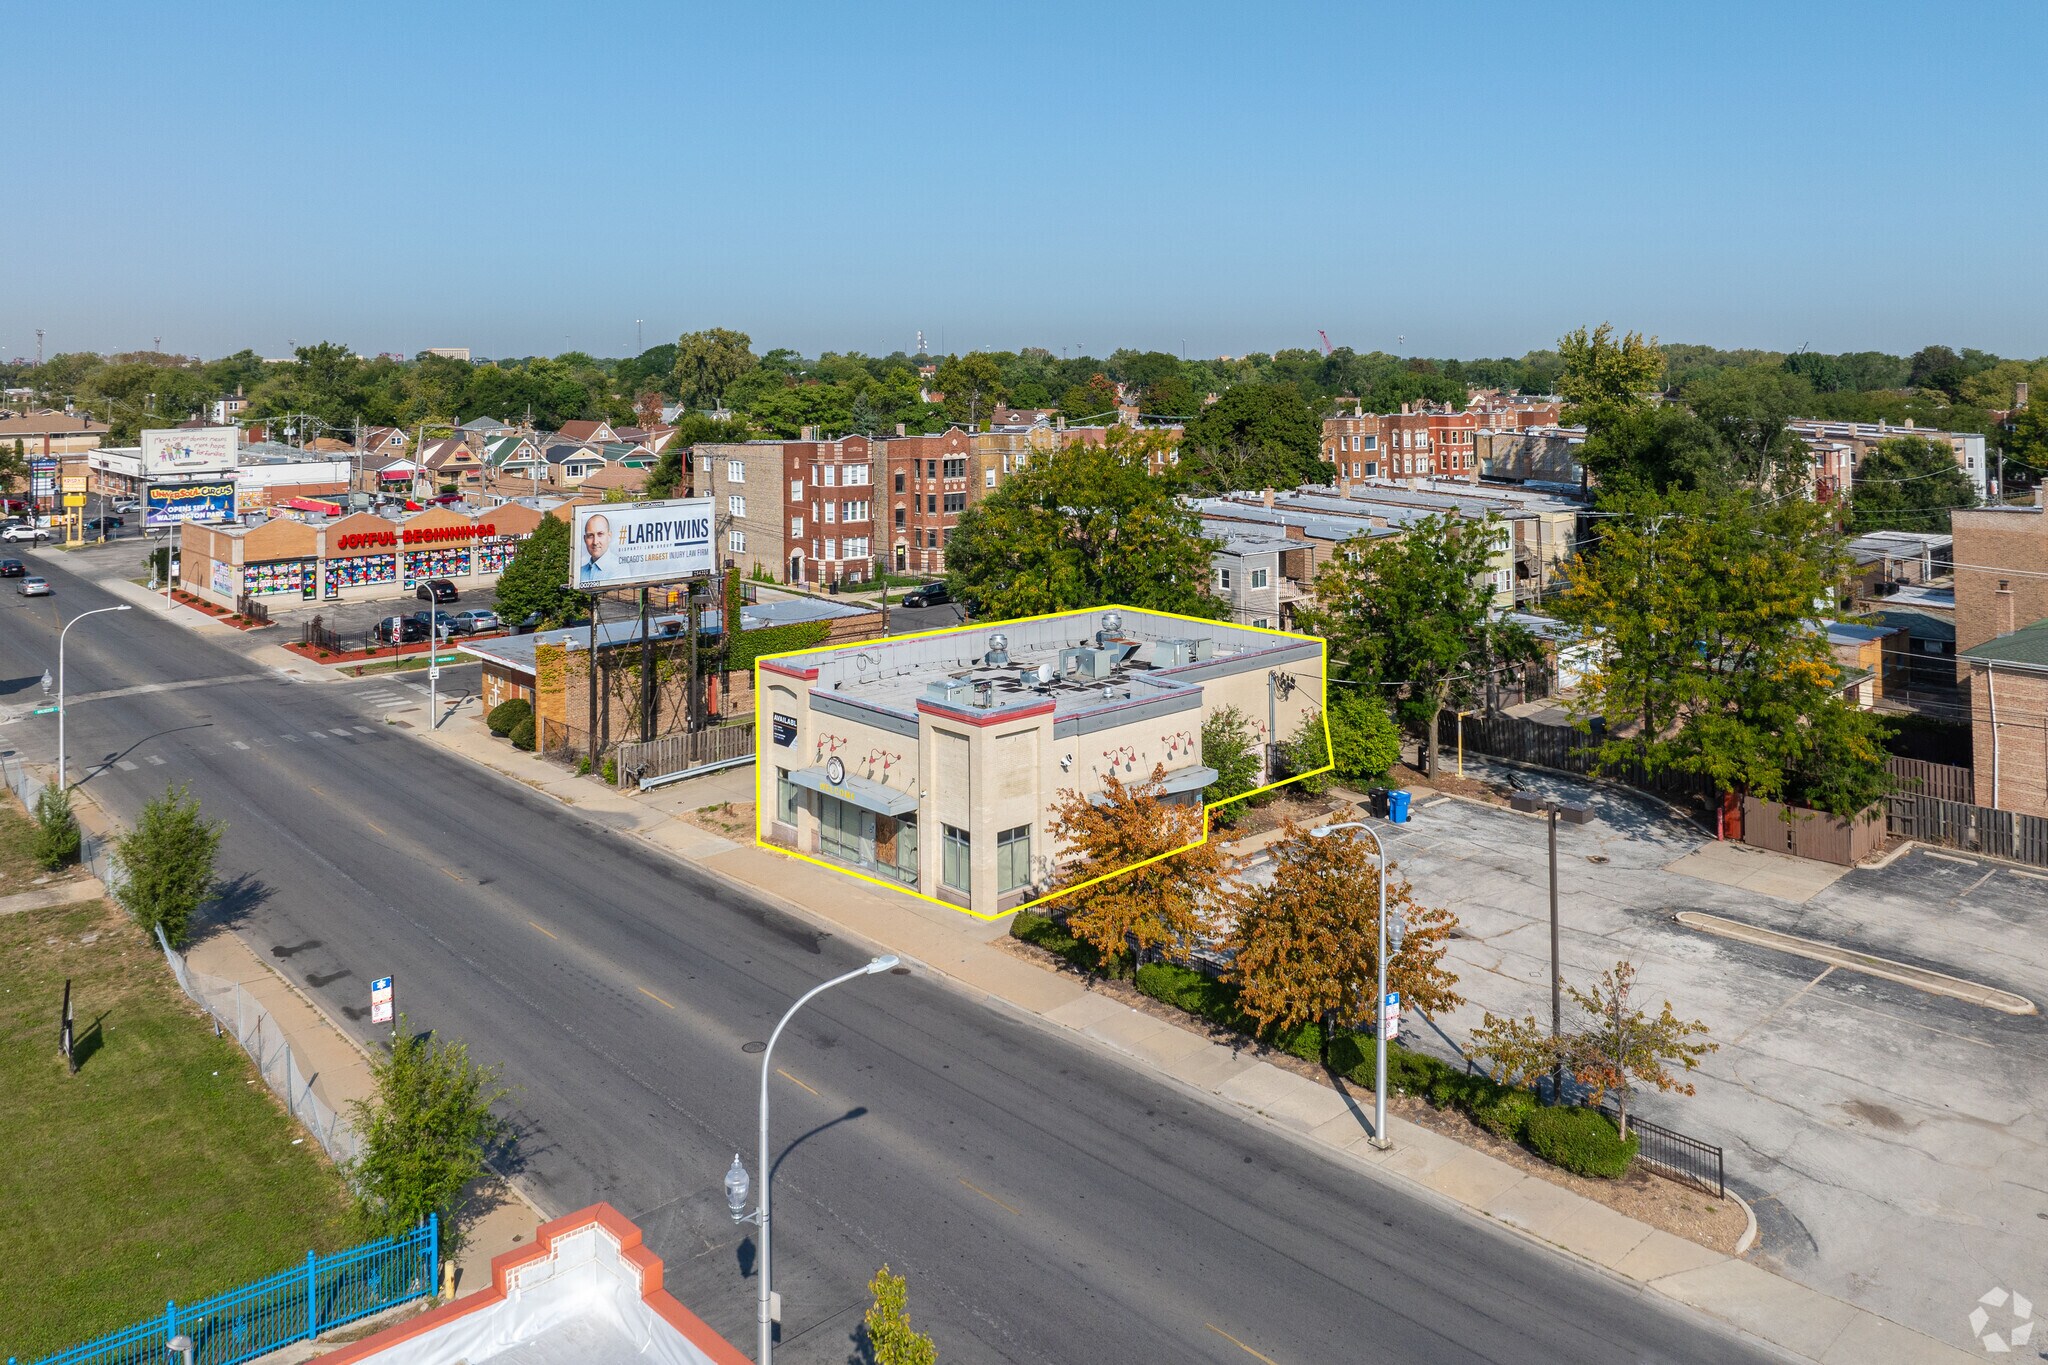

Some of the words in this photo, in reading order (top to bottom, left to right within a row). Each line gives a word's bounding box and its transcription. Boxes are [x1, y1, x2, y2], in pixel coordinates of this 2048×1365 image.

[156, 512, 206, 521] WASHINGTON
[206, 510, 226, 518] PARK
[167, 504, 192, 513] OPENS
[338, 532, 397, 548] JOYFUL
[403, 523, 496, 543] BEGINNINGS
[618, 554, 644, 565] CHICAGO'S
[645, 552, 669, 562] LARGEST
[669, 551, 685, 560] INJURY
[686, 550, 696, 558] LAW
[697, 548, 709, 556] FIRM
[820, 783, 855, 800] WELCOME
